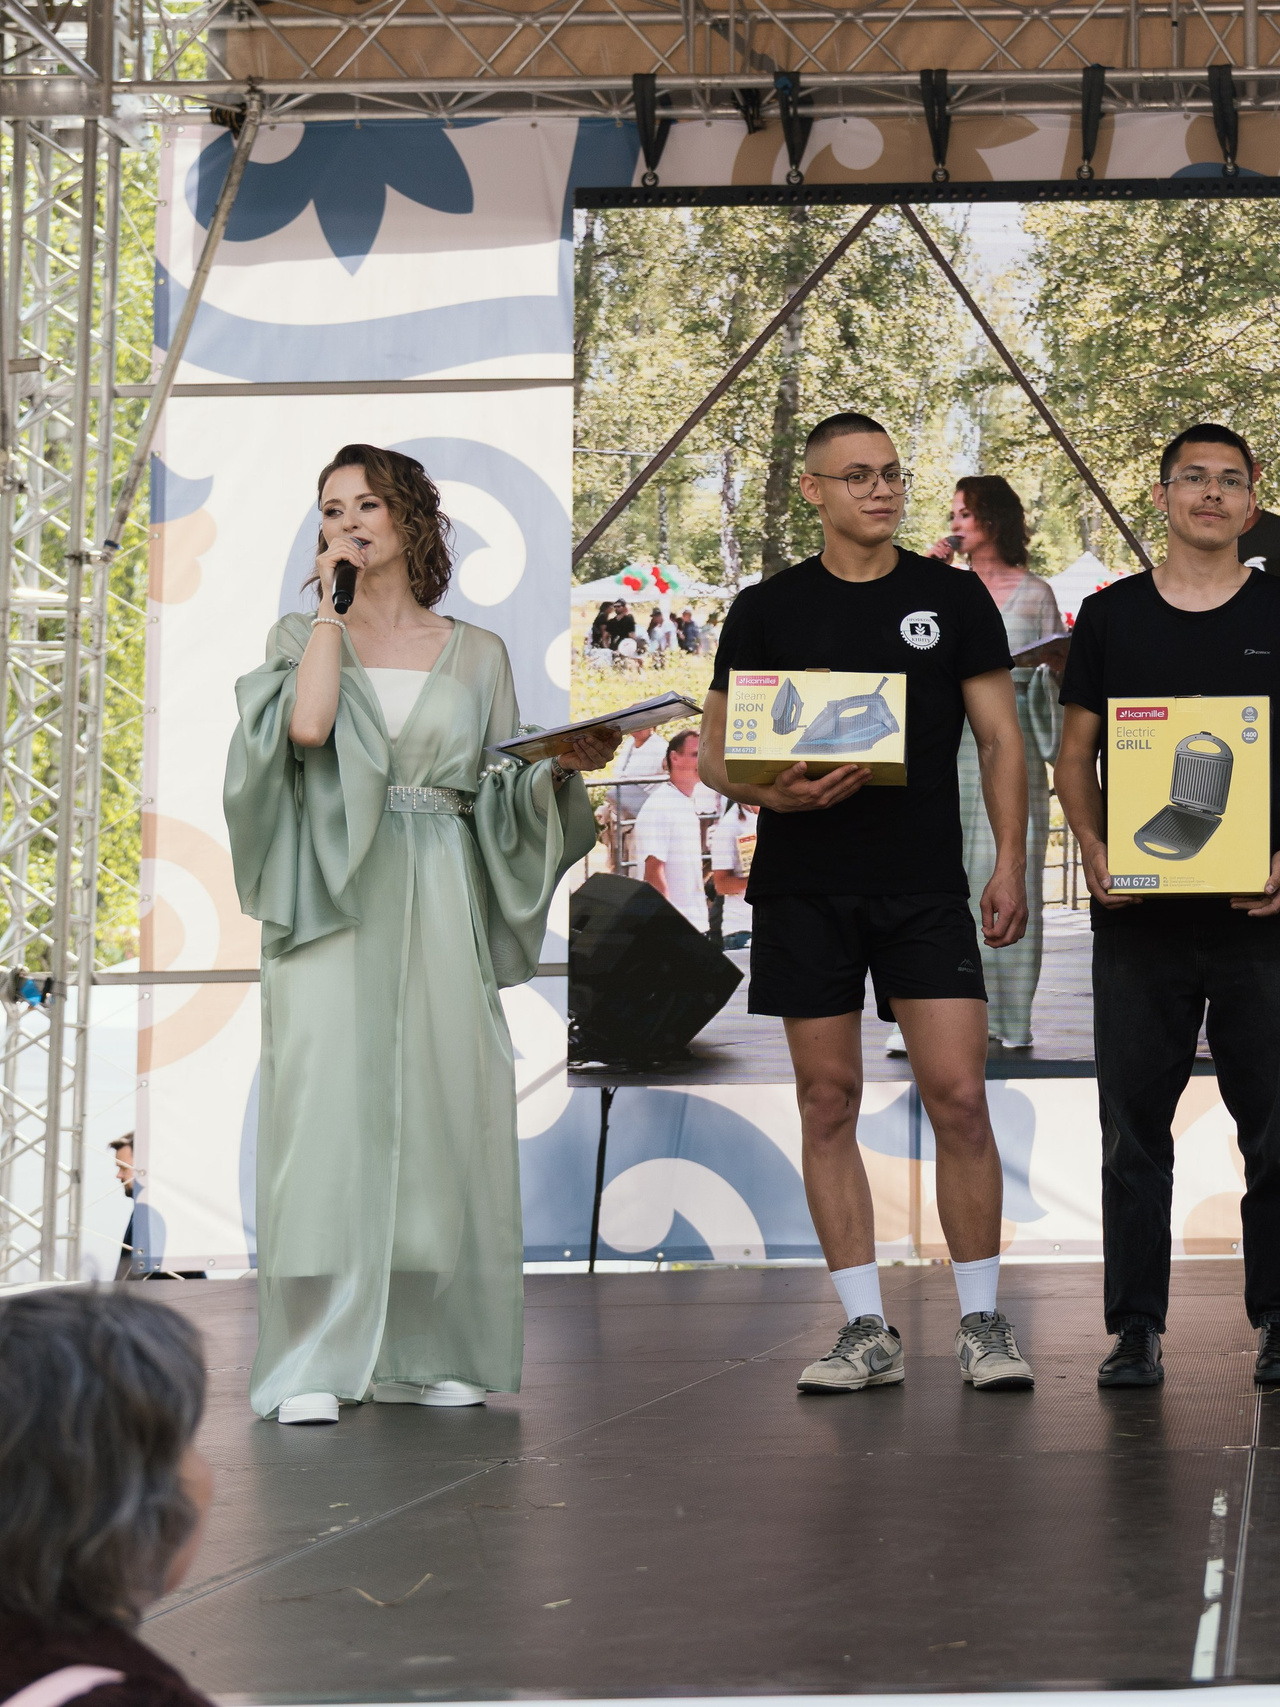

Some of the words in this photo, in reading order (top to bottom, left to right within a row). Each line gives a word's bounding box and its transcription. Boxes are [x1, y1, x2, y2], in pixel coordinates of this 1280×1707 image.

[745, 677, 776, 685] kamille
[735, 690, 766, 700] Steam
[735, 703, 764, 712] IRON
[1127, 709, 1165, 718] kamille
[1116, 726, 1156, 738] Electric
[1116, 739, 1152, 750] GRILL
[1113, 877, 1131, 887] KM
[1132, 876, 1157, 887] 6725
